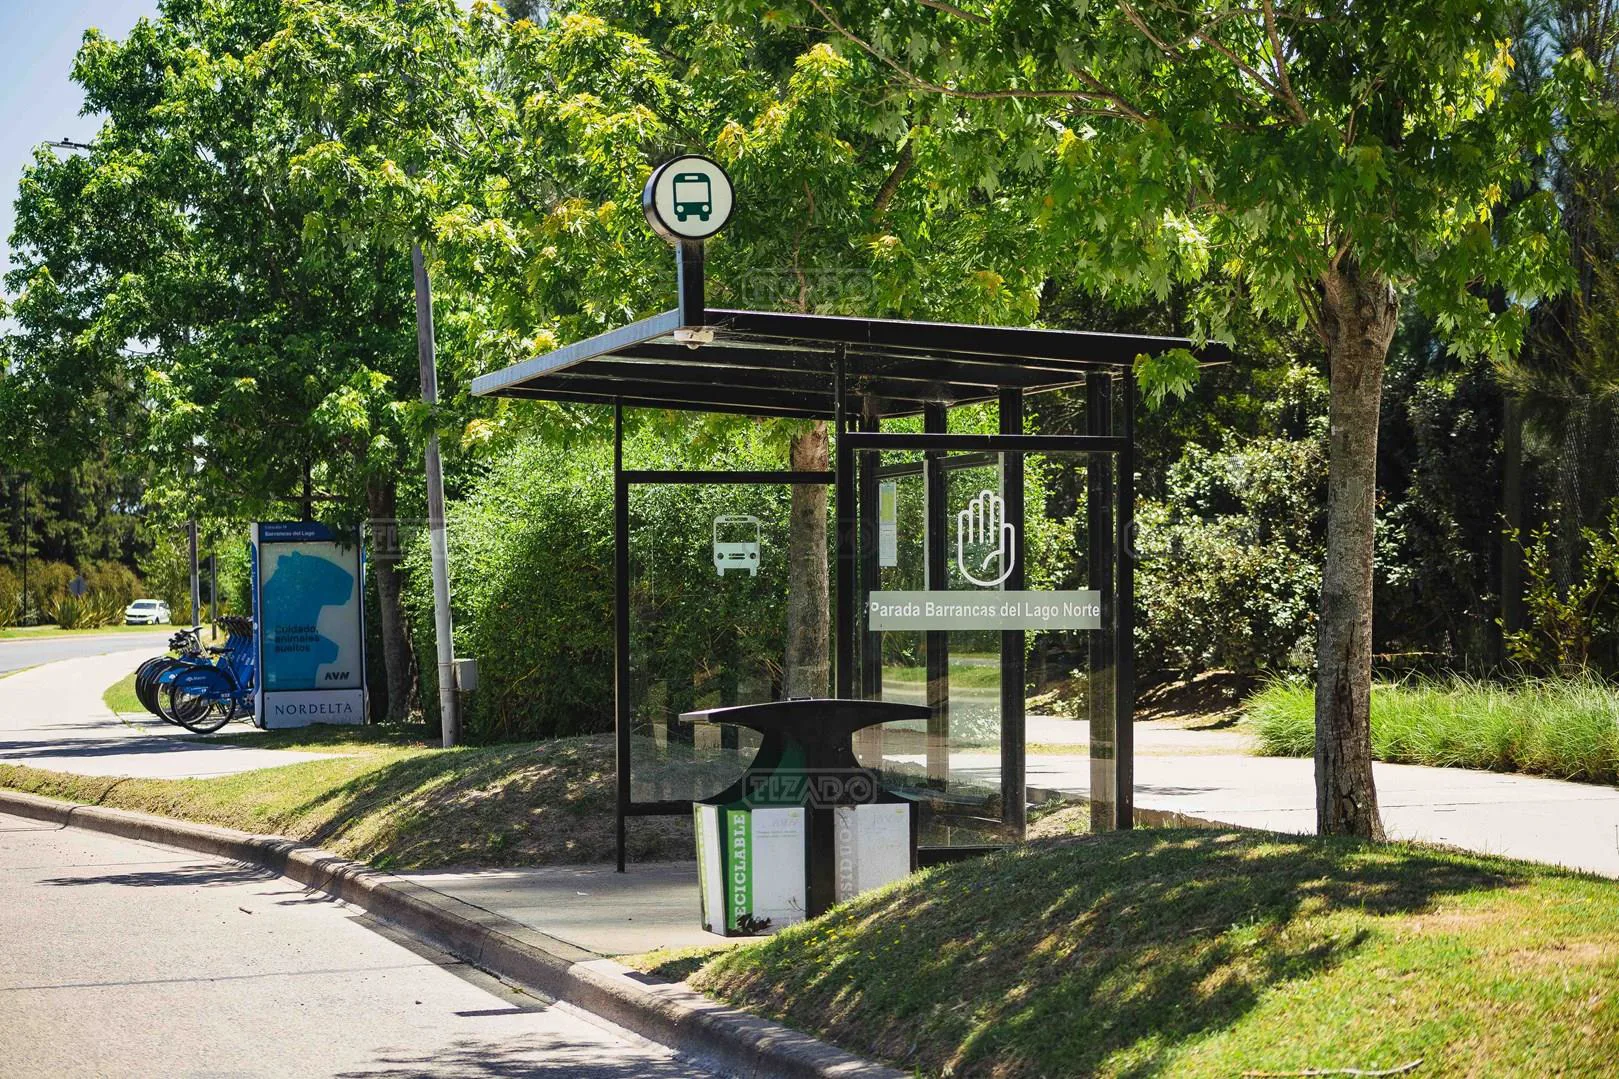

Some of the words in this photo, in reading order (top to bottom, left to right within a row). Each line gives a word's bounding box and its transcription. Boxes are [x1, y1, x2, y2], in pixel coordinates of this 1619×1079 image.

[871, 602, 920, 617] Parada
[925, 602, 996, 617] Barrancas
[1000, 602, 1020, 617] del
[1025, 602, 1059, 620] Lago
[1063, 602, 1100, 617] Norte
[275, 634, 320, 643] animales
[275, 703, 353, 715] NORDELTA
[734, 814, 747, 928] ECICLABLE
